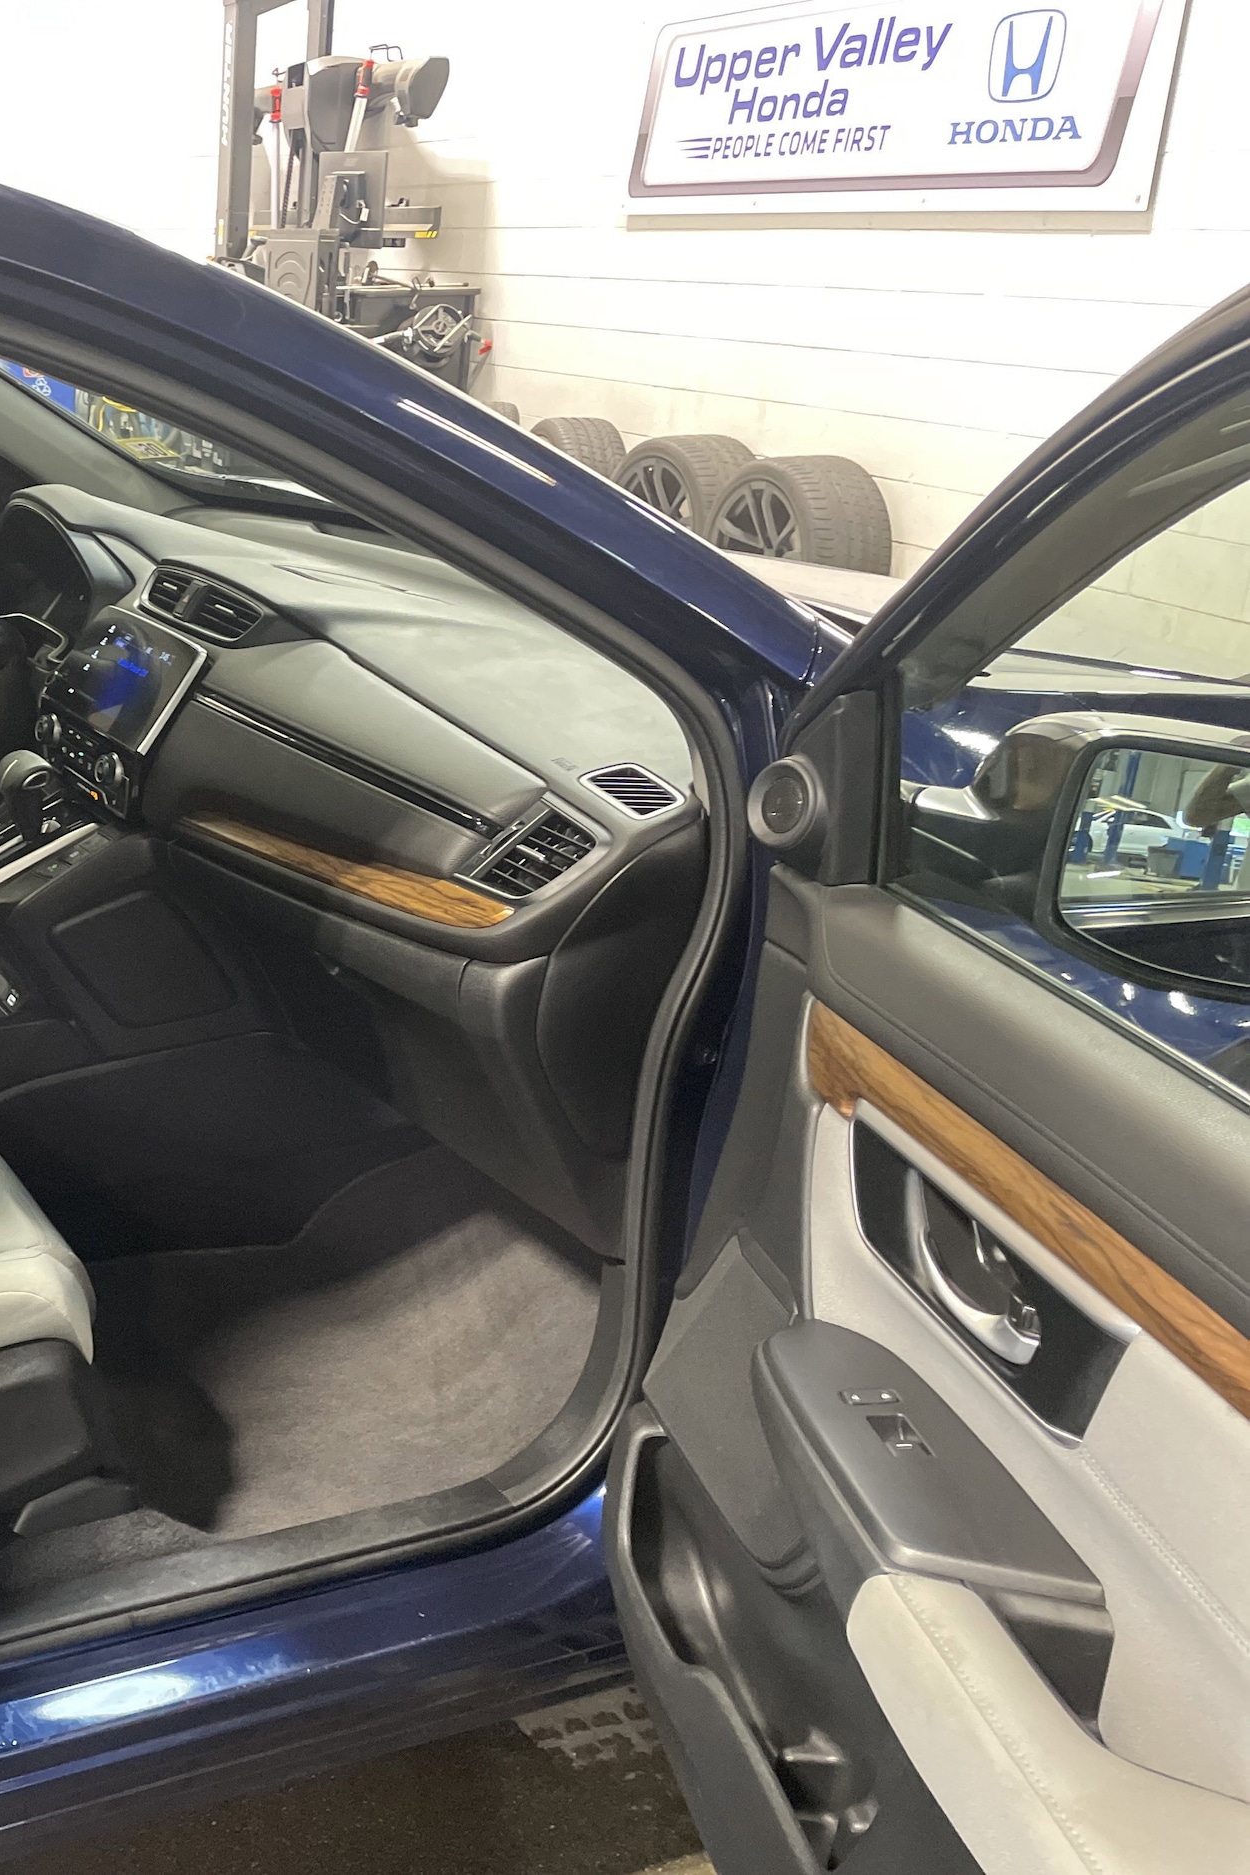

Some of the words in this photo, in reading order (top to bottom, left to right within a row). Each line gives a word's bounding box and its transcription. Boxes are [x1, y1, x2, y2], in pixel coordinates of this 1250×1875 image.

[674, 43, 801, 95] Upper
[815, 16, 953, 71] Valley
[728, 79, 849, 124] Honda
[711, 133, 775, 159] PEOPLE
[778, 128, 828, 156] COME
[832, 125, 891, 153] FIRST
[947, 115, 1082, 145] HONDA
